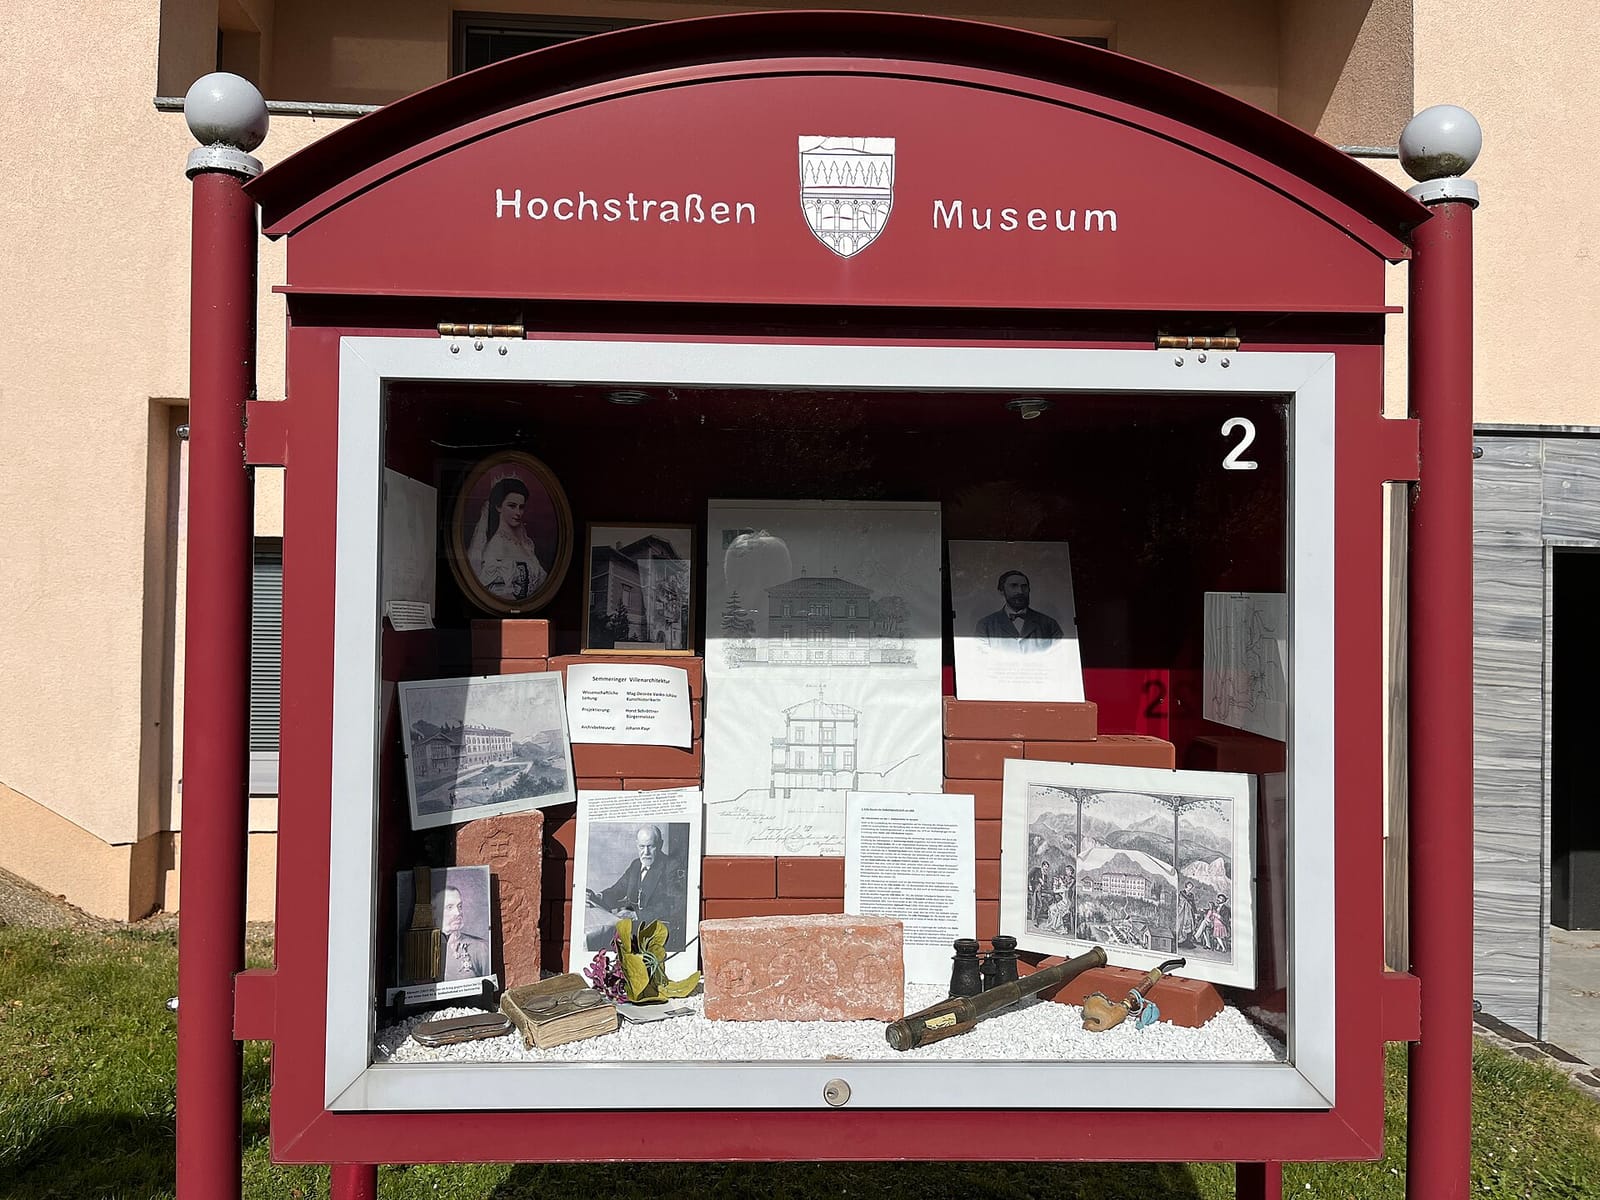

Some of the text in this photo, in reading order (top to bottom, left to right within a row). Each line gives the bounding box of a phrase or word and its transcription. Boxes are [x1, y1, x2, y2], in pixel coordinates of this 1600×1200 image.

[495, 188, 1119, 233] Hochstraßen Museum
[1221, 417, 1258, 471] 2
